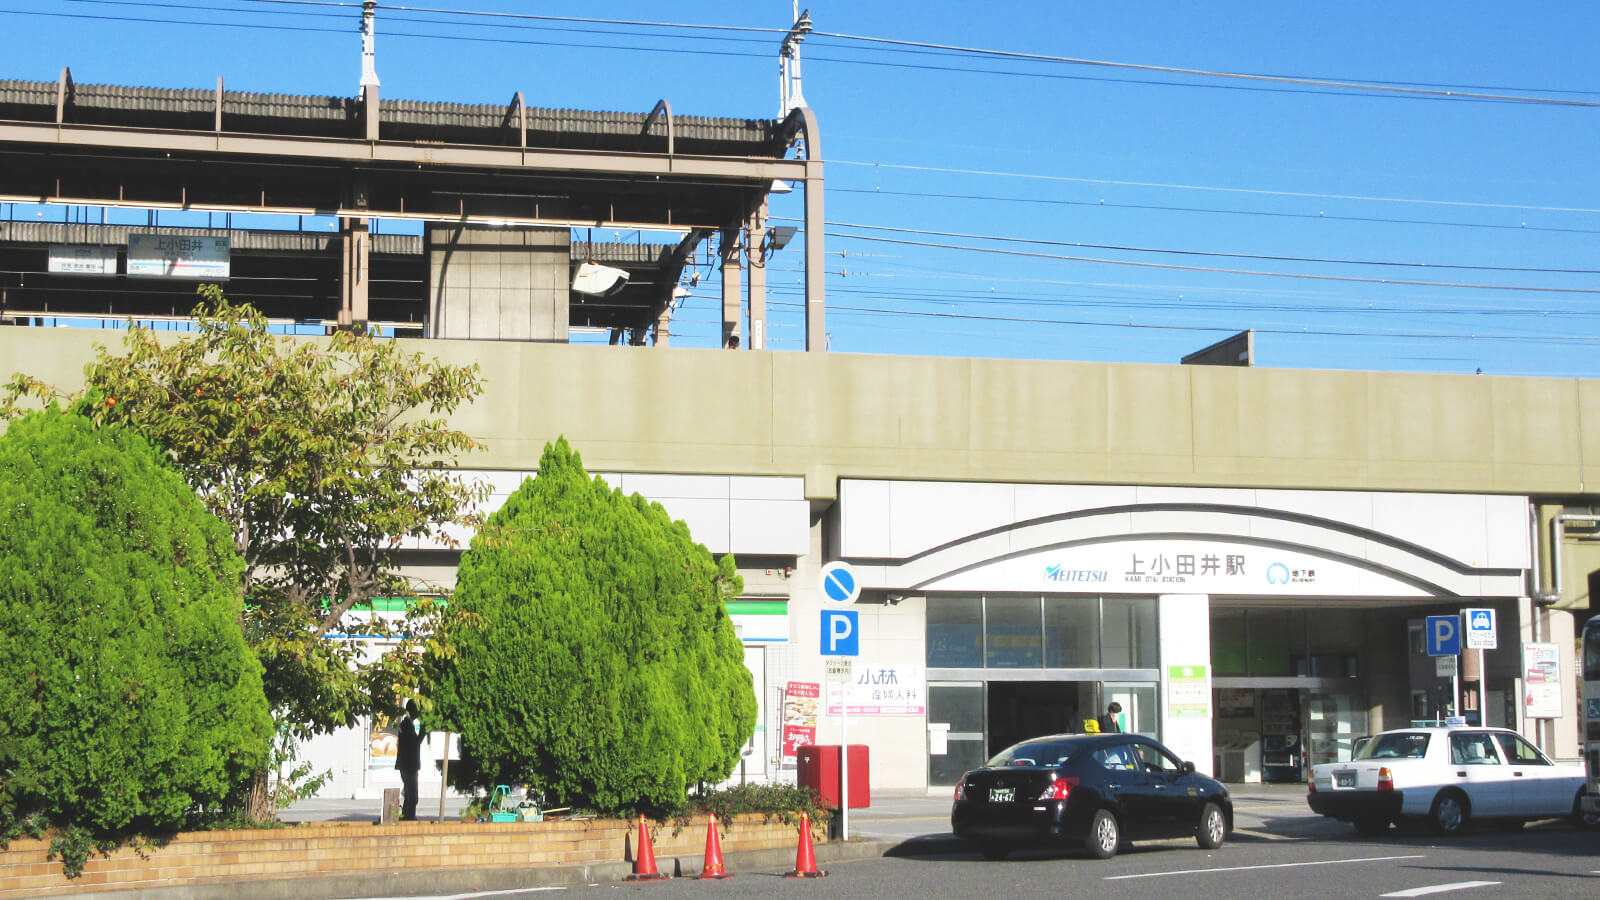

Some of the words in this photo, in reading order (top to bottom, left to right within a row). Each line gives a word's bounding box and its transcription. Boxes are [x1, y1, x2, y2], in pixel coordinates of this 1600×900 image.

[154, 237, 204, 252] 上小田井
[1043, 563, 1108, 582] MEITETSU
[1125, 553, 1246, 576] 上小田井駅
[830, 615, 852, 651] P
[1436, 620, 1454, 651] P
[857, 668, 898, 685] 小林
